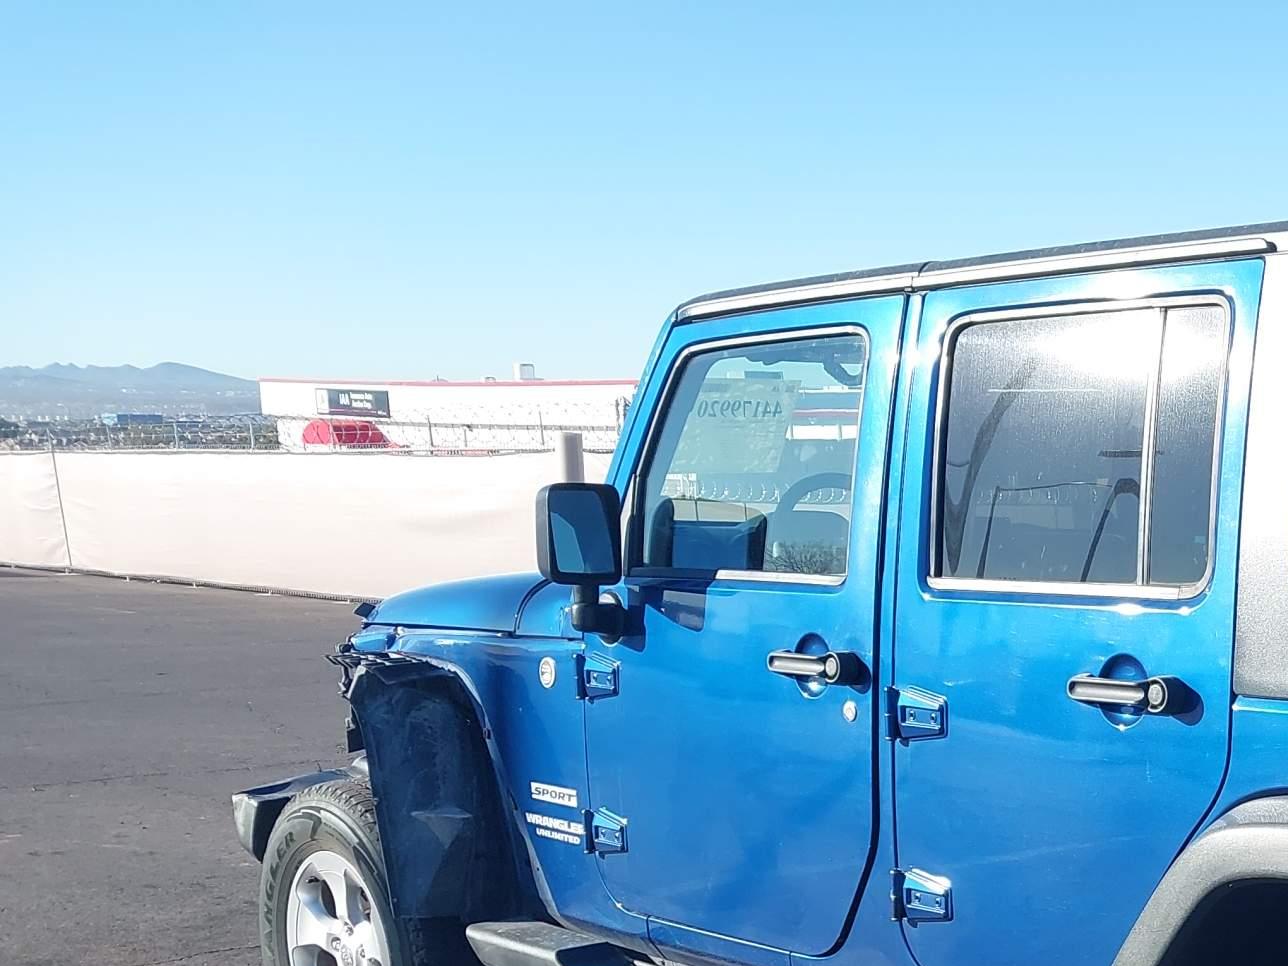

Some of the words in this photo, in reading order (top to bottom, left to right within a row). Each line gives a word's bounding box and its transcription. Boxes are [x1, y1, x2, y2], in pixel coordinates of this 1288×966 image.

[534, 786, 577, 802] SPORT
[524, 811, 587, 835] WRANGLER
[535, 827, 581, 845] UNLIMITED
